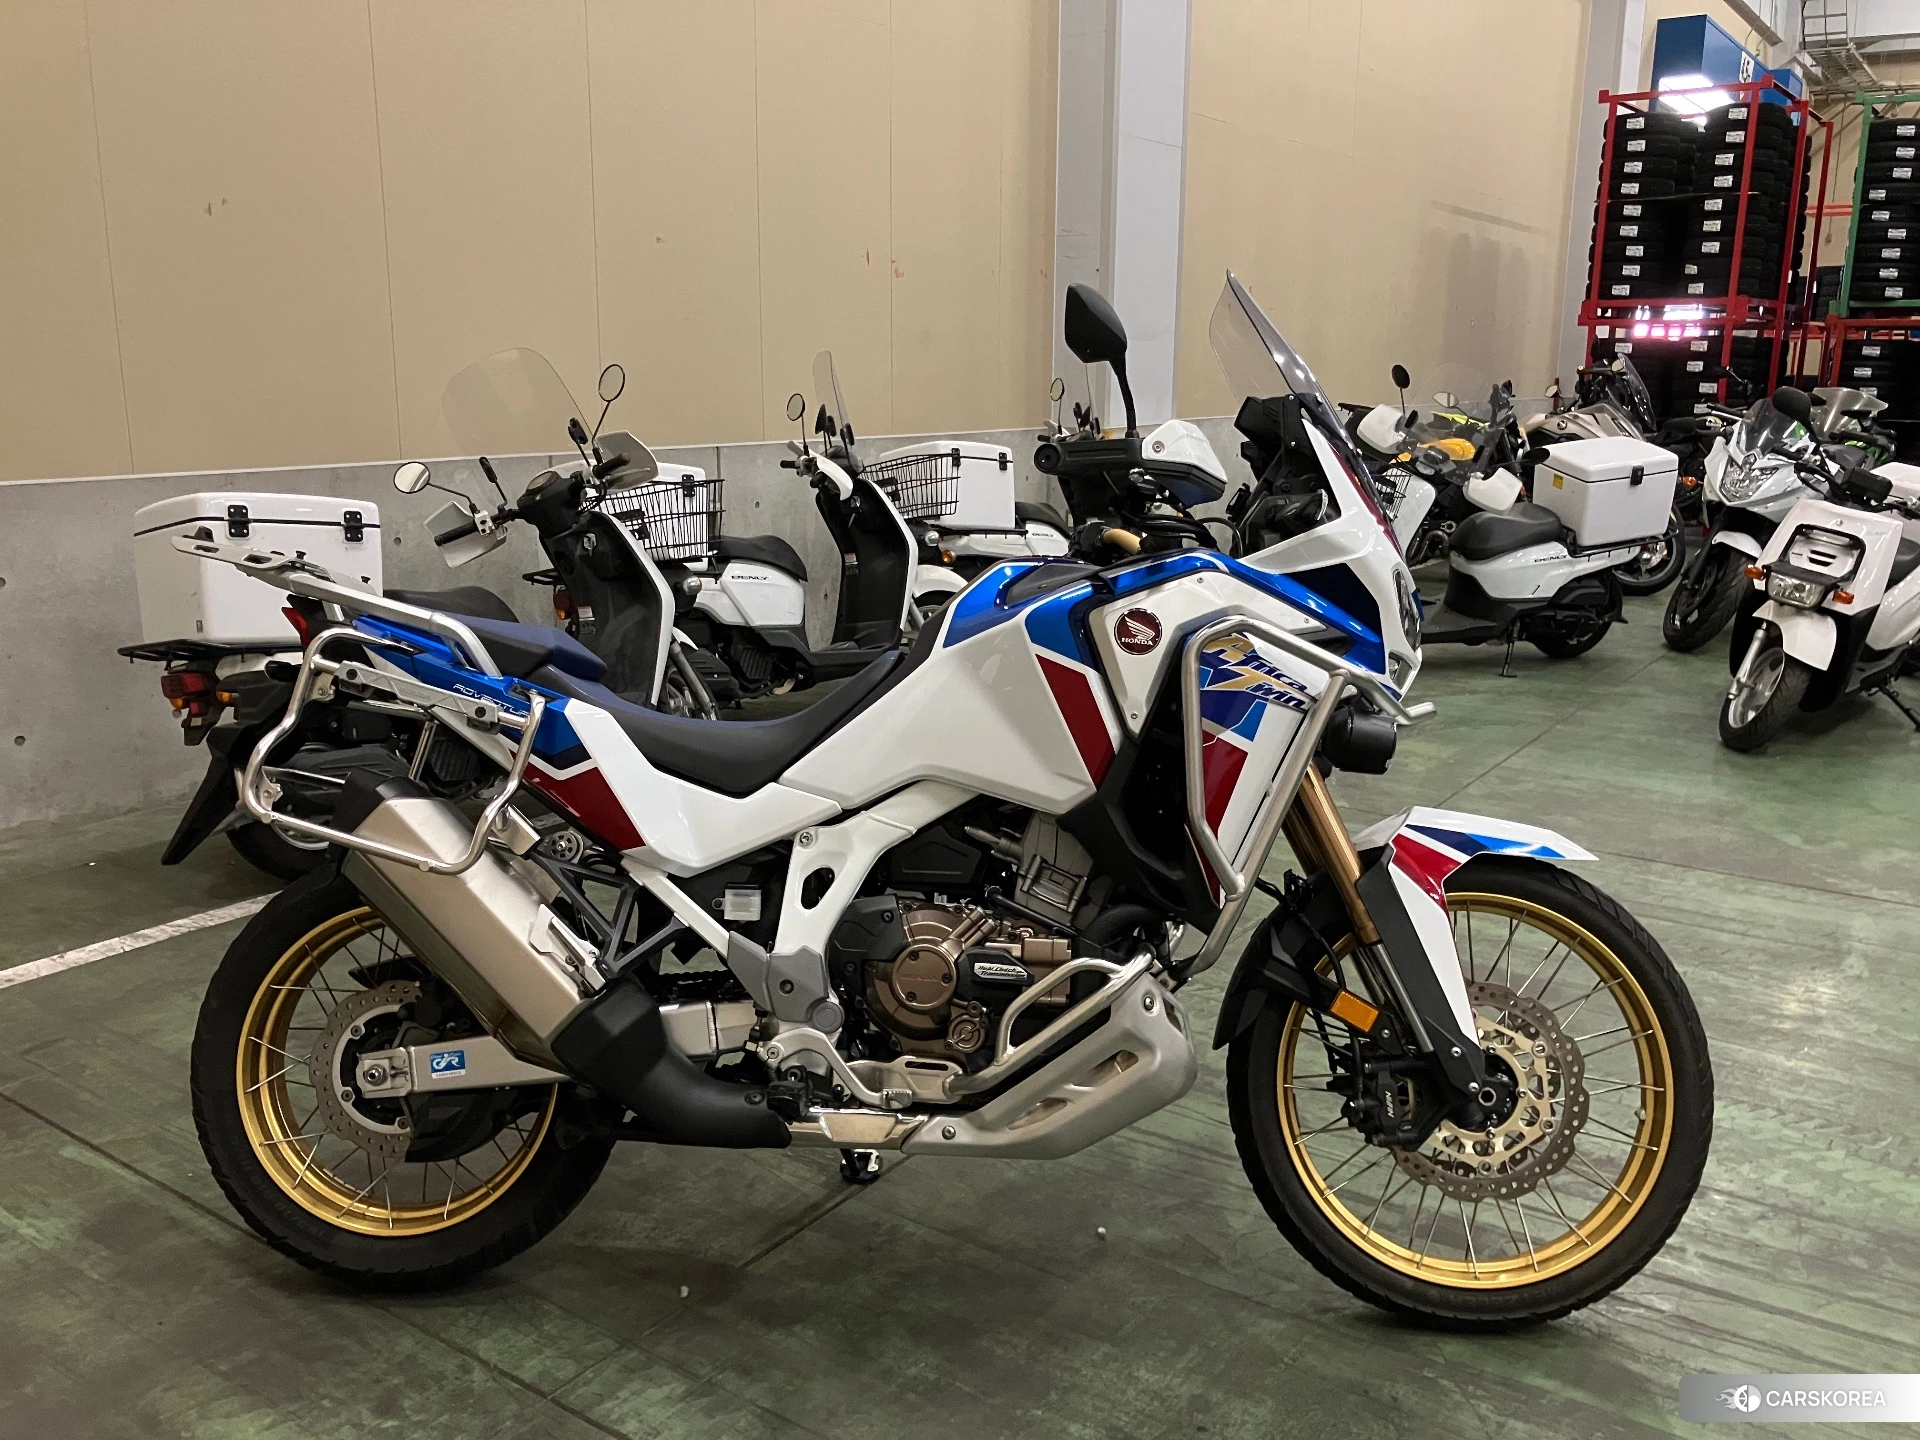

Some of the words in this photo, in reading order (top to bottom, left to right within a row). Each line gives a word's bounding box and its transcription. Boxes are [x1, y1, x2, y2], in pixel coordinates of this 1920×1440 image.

[731, 573, 768, 581] BENLY
[1121, 637, 1154, 646] HONDA
[1202, 632, 1308, 693] Africa
[453, 683, 530, 717] ADVETUR
[1206, 666, 1306, 710] Twin
